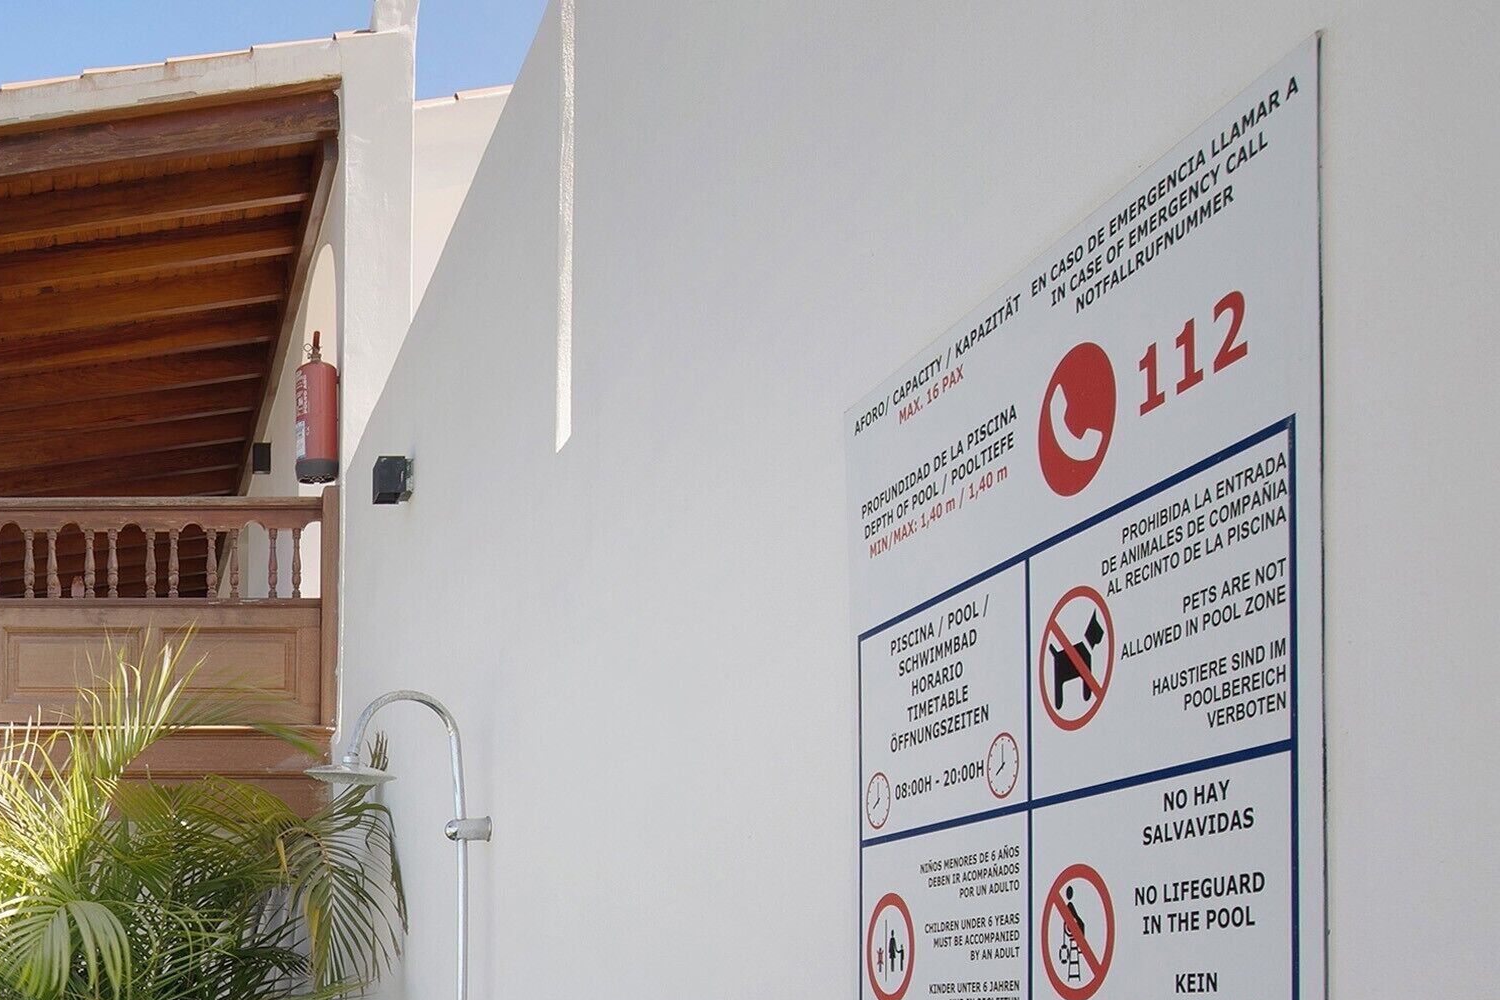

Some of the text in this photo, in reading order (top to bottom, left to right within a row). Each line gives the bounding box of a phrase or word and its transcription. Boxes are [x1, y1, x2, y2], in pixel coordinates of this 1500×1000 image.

[1031, 76, 1299, 297] EN CASO DE EMERGENCIA LLAMAR A
[1051, 131, 1268, 307] IN CASE OF EMERGENCY CALL
[1076, 184, 1234, 314] NOTFALLRUFNUMMER
[854, 395, 890, 436] AFORO/
[892, 355, 942, 406] CAPACITY
[955, 293, 1021, 359] KAPAZITÄT
[1139, 290, 1248, 417] 112
[899, 363, 964, 425] MAX. 16 PAX
[861, 404, 1017, 519] PROFUNDIDAD DE LA PISCINA
[864, 508, 893, 540] DEPTH
[896, 498, 909, 519] OF
[911, 481, 939, 510] POOL
[951, 431, 1014, 485] POOLTIEFE
[869, 518, 917, 559] MIN/MAX:
[920, 502, 943, 529] 1,40
[945, 497, 955, 513] m
[968, 471, 993, 500] 1,40
[996, 465, 1008, 483] m
[1122, 451, 1287, 544] PROHIBIDA LA ENTRADA
[1101, 478, 1287, 576] DE ANIMALES DE COMPAÑIA
[1106, 505, 1287, 597] AL RECINTO DE LA PISCINA
[1183, 557, 1286, 613] PETS ARE NOT
[890, 621, 935, 656] PISCINA
[947, 601, 979, 630] POOL
[1120, 584, 1286, 660] ALLOWED IN POOL ZONE
[898, 628, 977, 677] SCHWIMMBAD
[1152, 637, 1286, 696] HAUSTIERE SIND IM
[911, 660, 963, 696] HORARIO
[1184, 664, 1286, 711] POOLBEREICH
[907, 684, 968, 722] TIMETABLE
[1207, 690, 1286, 728] VERBOTEN
[890, 703, 989, 753] ÖFFNUNGSZEITEN
[894, 775, 932, 800] 08:00H
[943, 759, 984, 787] 20:00H
[1163, 779, 1230, 812] NO HAY
[1142, 807, 1254, 846] SALVAVIDAS
[919, 845, 1020, 873] NIÑOS MENORES DE 6 AÑOS
[928, 862, 1020, 888] DEBEN IR ACOMPAÑADOS
[959, 878, 1020, 898] POR UN ADULTO
[1134, 871, 1265, 906] NO LIFEGUARD
[924, 912, 1020, 934] CHILDREN UNDER 6 YEARS
[933, 929, 1020, 948] MUST BE ACCOMPANIED
[1142, 905, 1255, 935] IN THE POOL
[970, 946, 1020, 961] BY AN ADULT
[928, 980, 1020, 994] KINDER UNTER 6 JAHREN
[1175, 972, 1217, 993] KEIN
